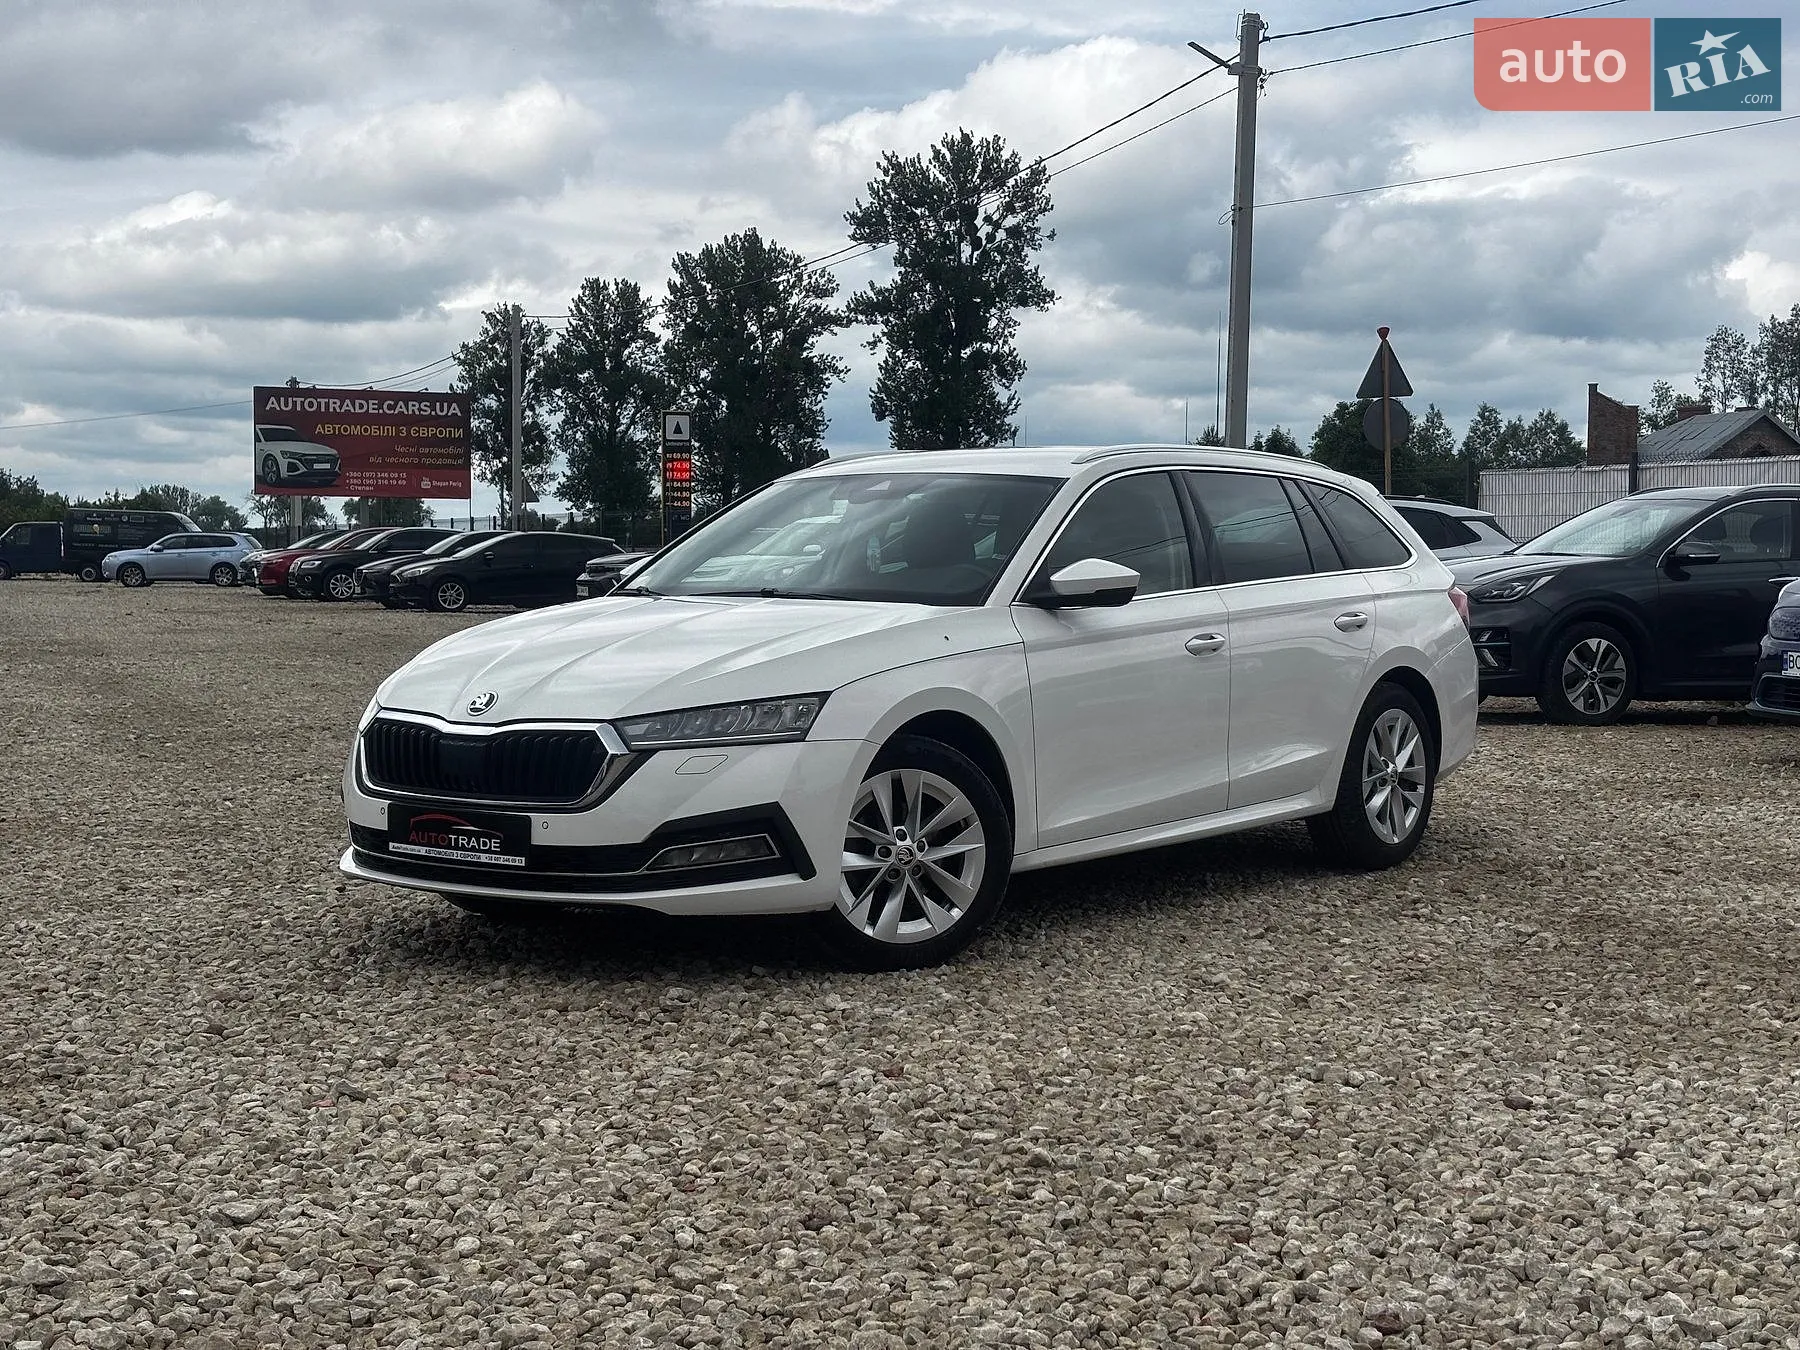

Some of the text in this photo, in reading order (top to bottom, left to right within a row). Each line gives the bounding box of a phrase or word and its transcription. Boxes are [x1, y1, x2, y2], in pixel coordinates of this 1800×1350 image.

[265, 396, 462, 417] AUTOTRADE.CARS.UA
[315, 424, 396, 437] АВТОМОБІЛІ
[411, 426, 464, 438] ЄВРОПИ
[394, 444, 464, 455] Чесні автомобілі
[369, 455, 382, 464] від
[408, 830, 501, 851] AUTOTRADE
